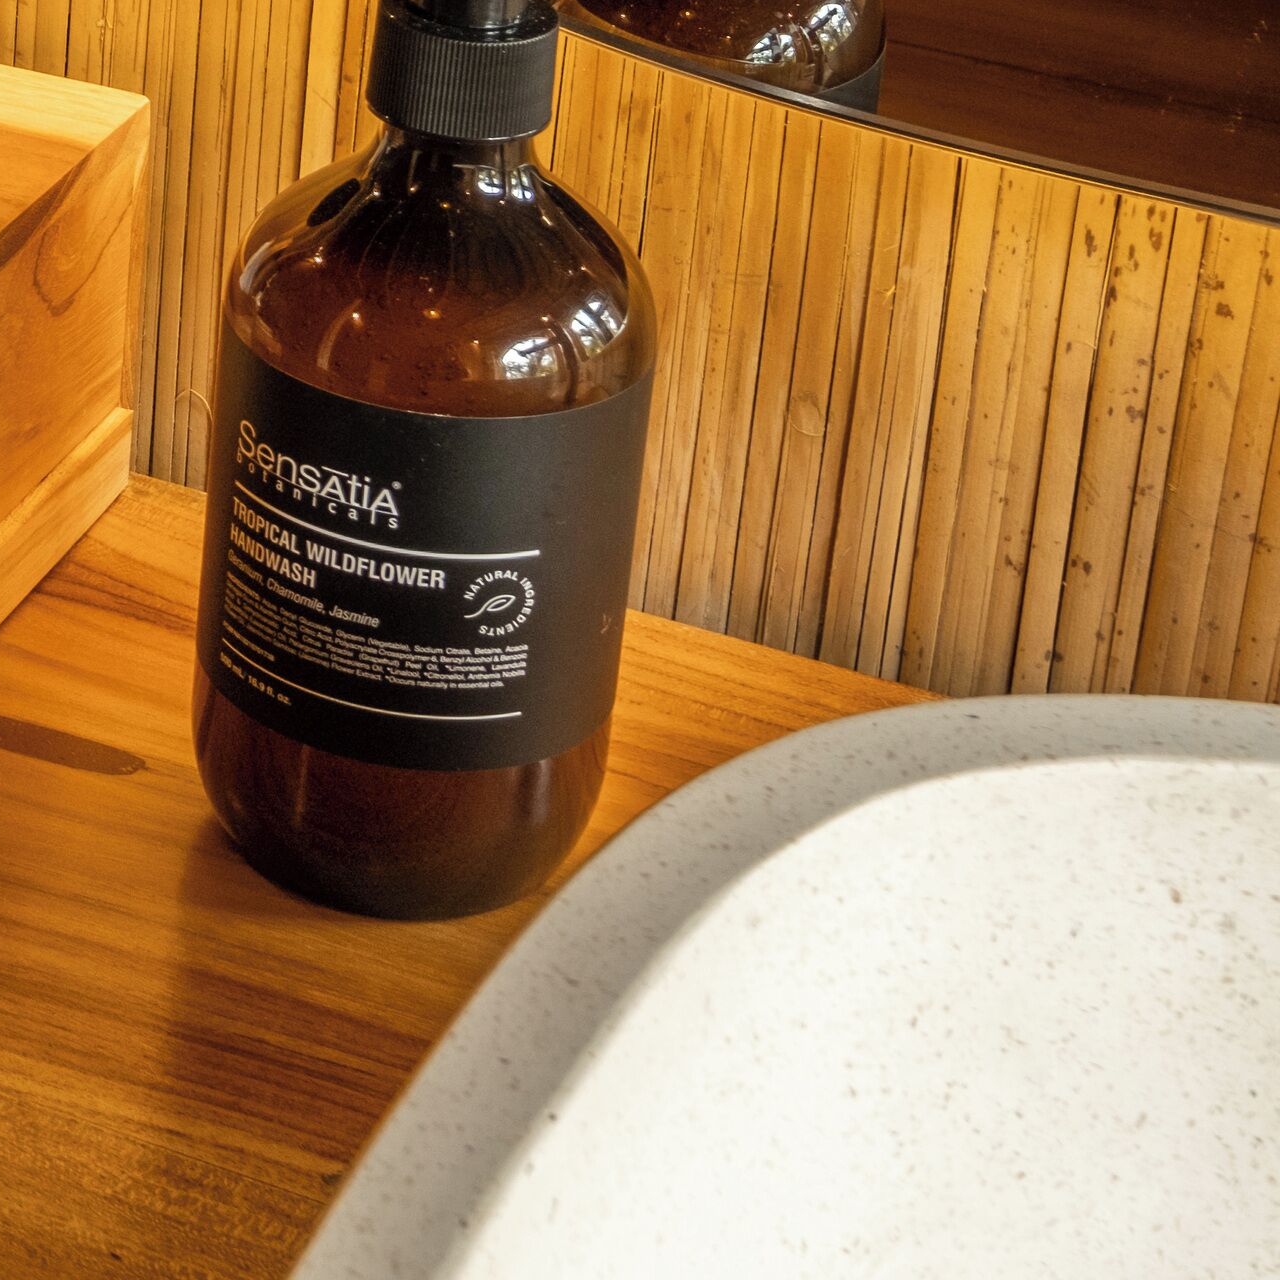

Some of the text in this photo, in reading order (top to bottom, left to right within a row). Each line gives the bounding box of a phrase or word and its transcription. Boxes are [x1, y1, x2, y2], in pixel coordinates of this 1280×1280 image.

[229, 522, 317, 589] HANDWASH
[232, 496, 446, 590] TROPICAL WILDFLOWER
[266, 577, 326, 615] Chamomile,
[329, 604, 380, 628] Jasmine
[463, 569, 536, 636] NATURAL INGREDIENTS
